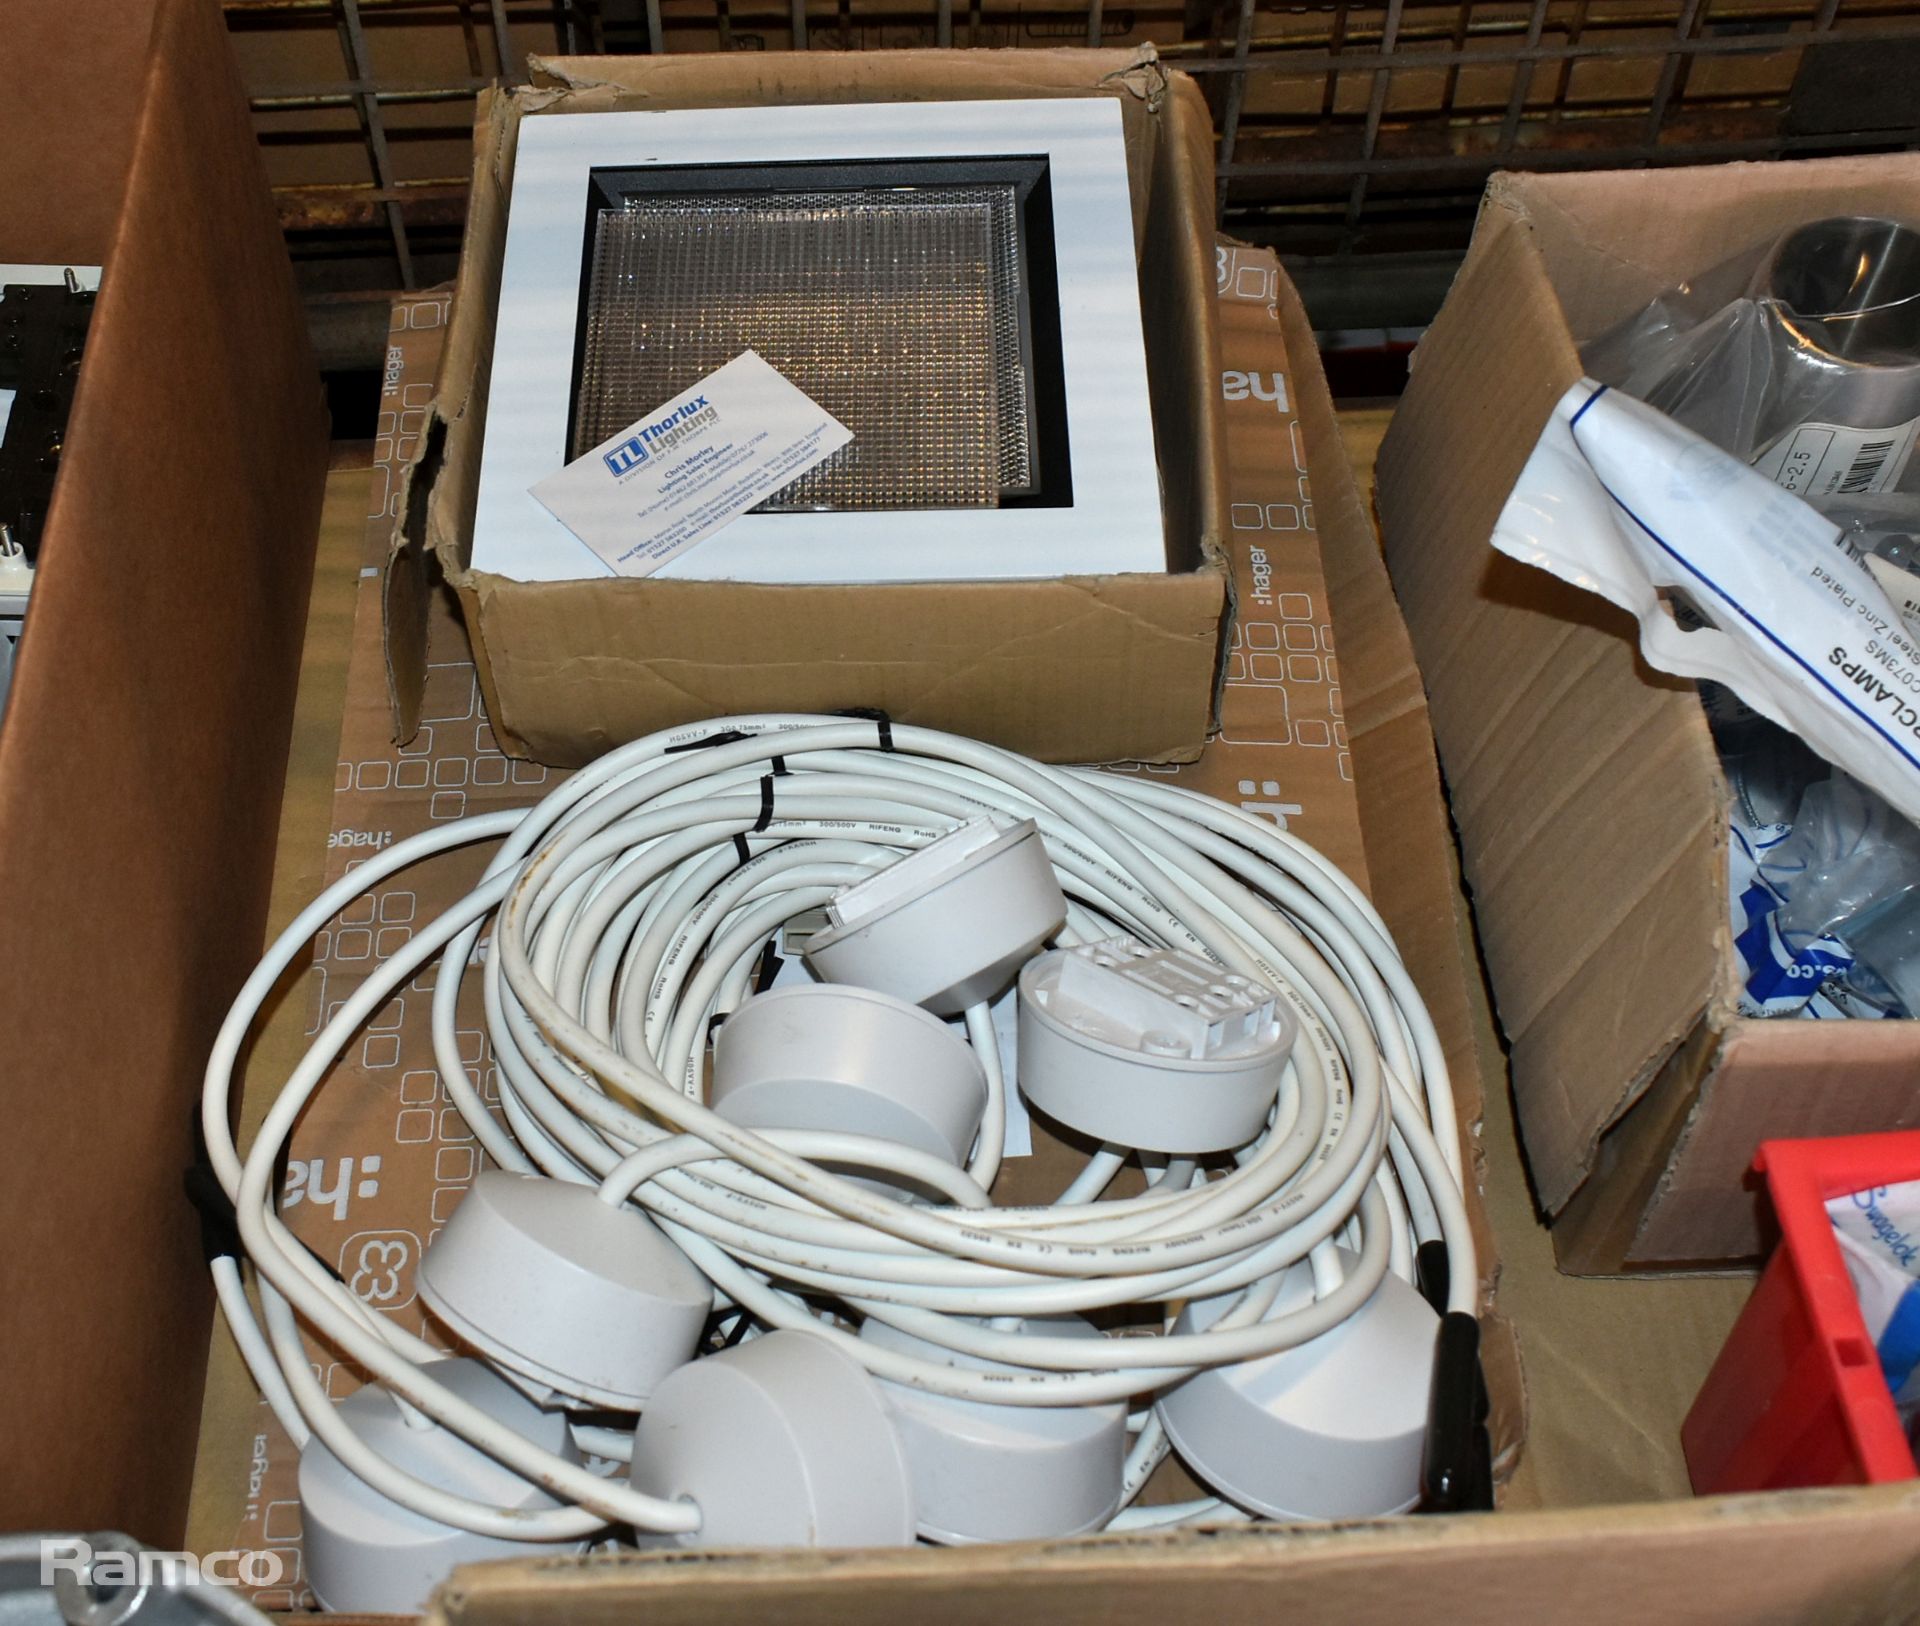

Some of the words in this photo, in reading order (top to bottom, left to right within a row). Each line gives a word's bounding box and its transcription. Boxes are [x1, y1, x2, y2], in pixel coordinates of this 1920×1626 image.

[638, 395, 708, 442] Thorlux
[649, 406, 718, 454] Lighting
[658, 473, 686, 494] Lighting
[686, 462, 703, 475] Sales
[704, 443, 733, 465] Engineer
[665, 462, 685, 479] Chris
[686, 444, 713, 466] Morley
[617, 550, 633, 562] Head
[633, 538, 652, 552] Office:
[683, 527, 698, 539] Sales
[1810, 566, 1853, 609] Plated
[1857, 604, 1892, 643] Zinc
